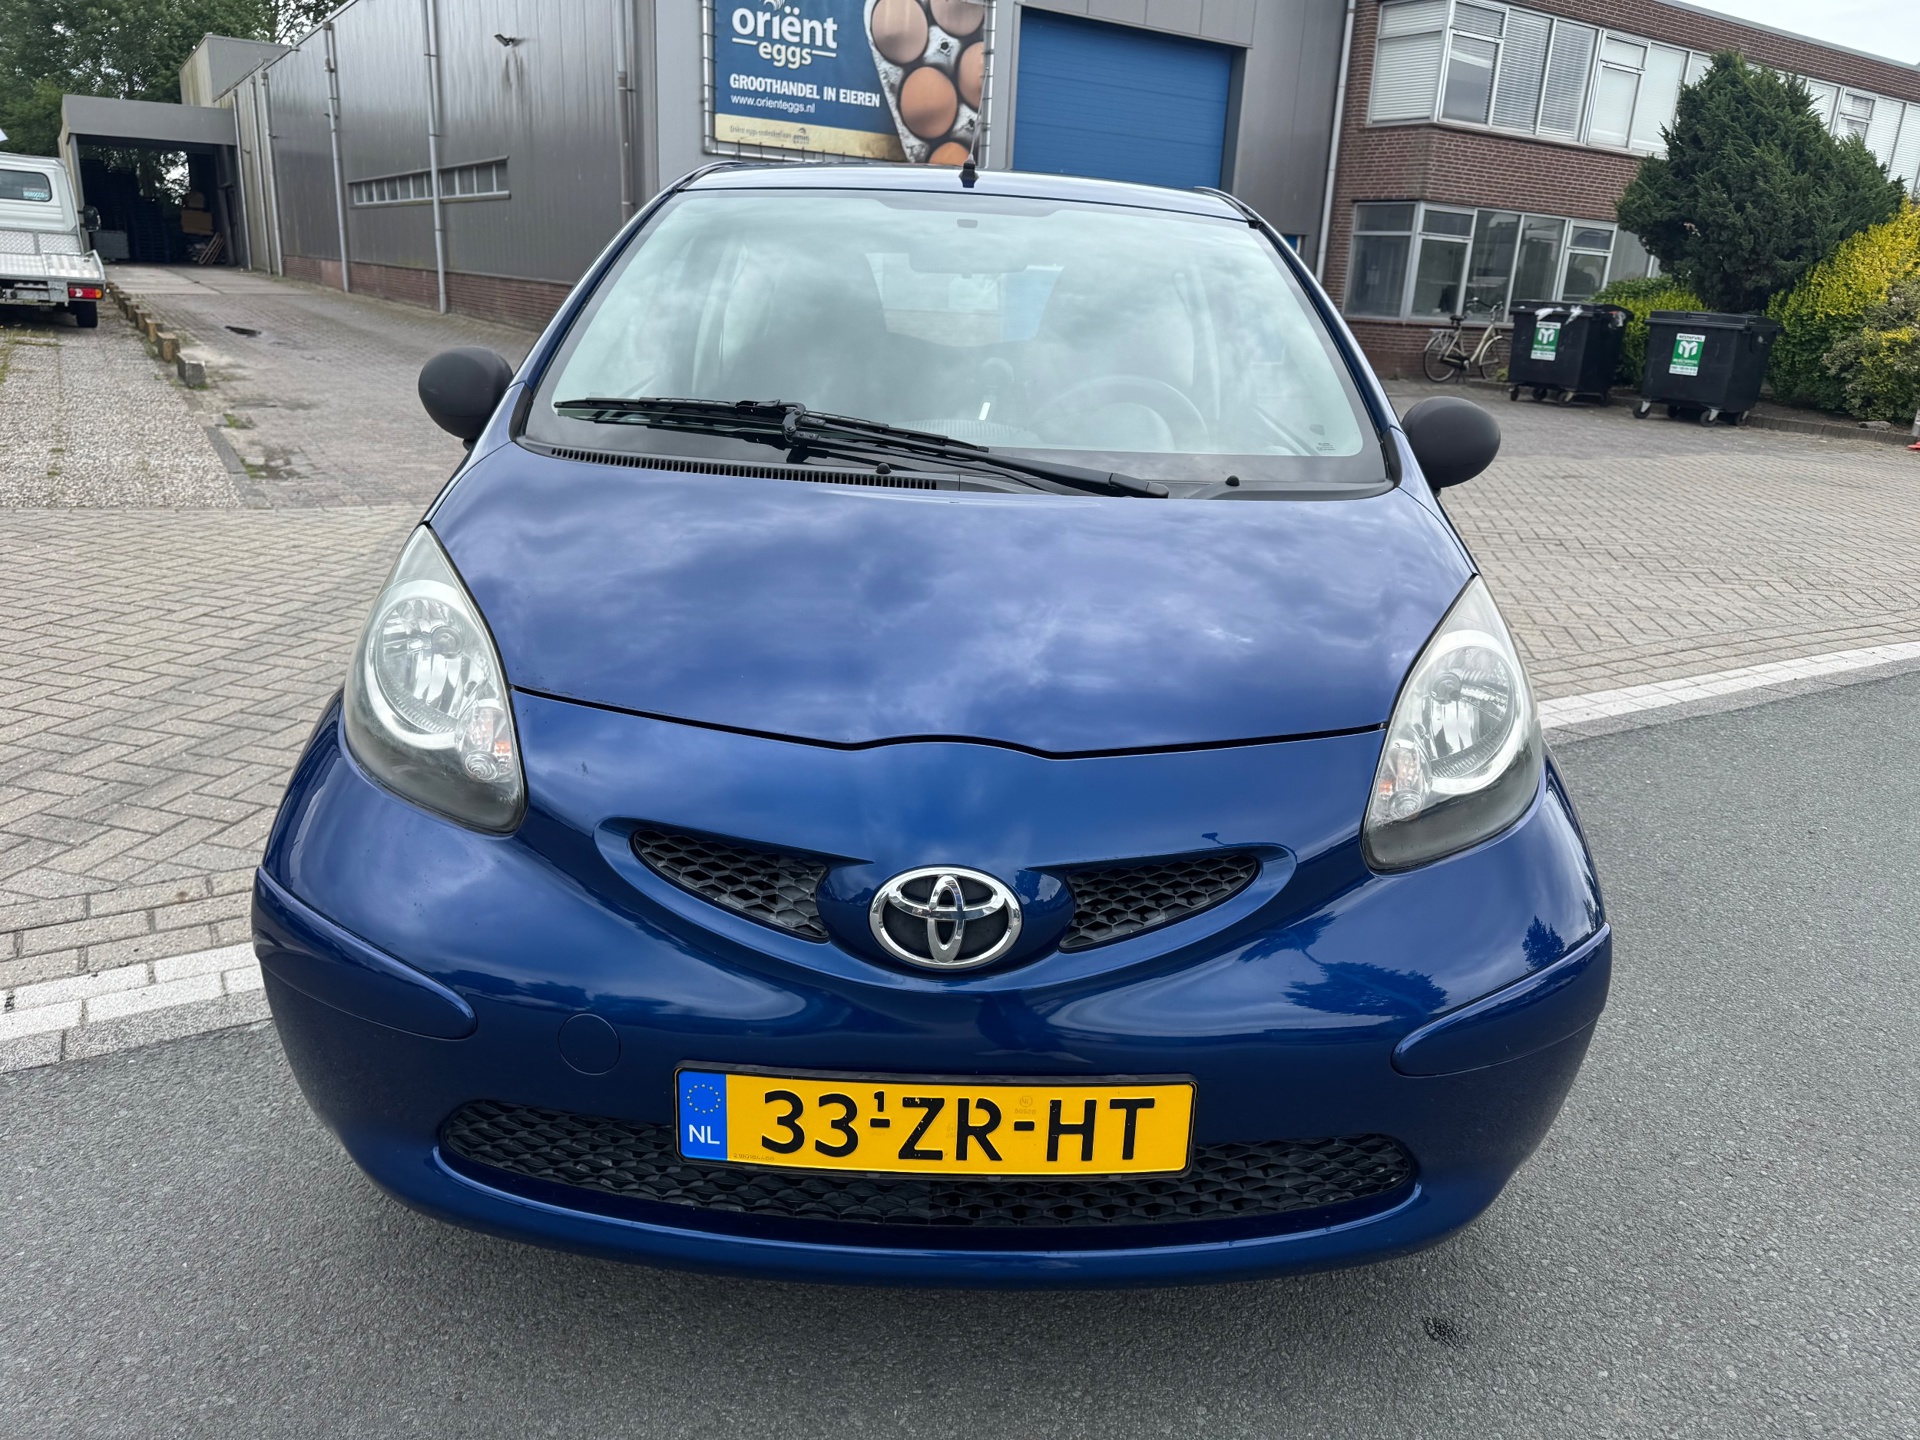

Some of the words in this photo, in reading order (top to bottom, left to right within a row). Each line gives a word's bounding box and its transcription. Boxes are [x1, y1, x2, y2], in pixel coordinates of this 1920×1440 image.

[758, 41, 812, 69] eggs
[730, 73, 820, 99] GROOTHANDEL
[823, 86, 836, 102] IN
[839, 88, 881, 107] EIEREN
[730, 94, 816, 114] www.orienteggs.nl
[688, 1124, 720, 1145] NL
